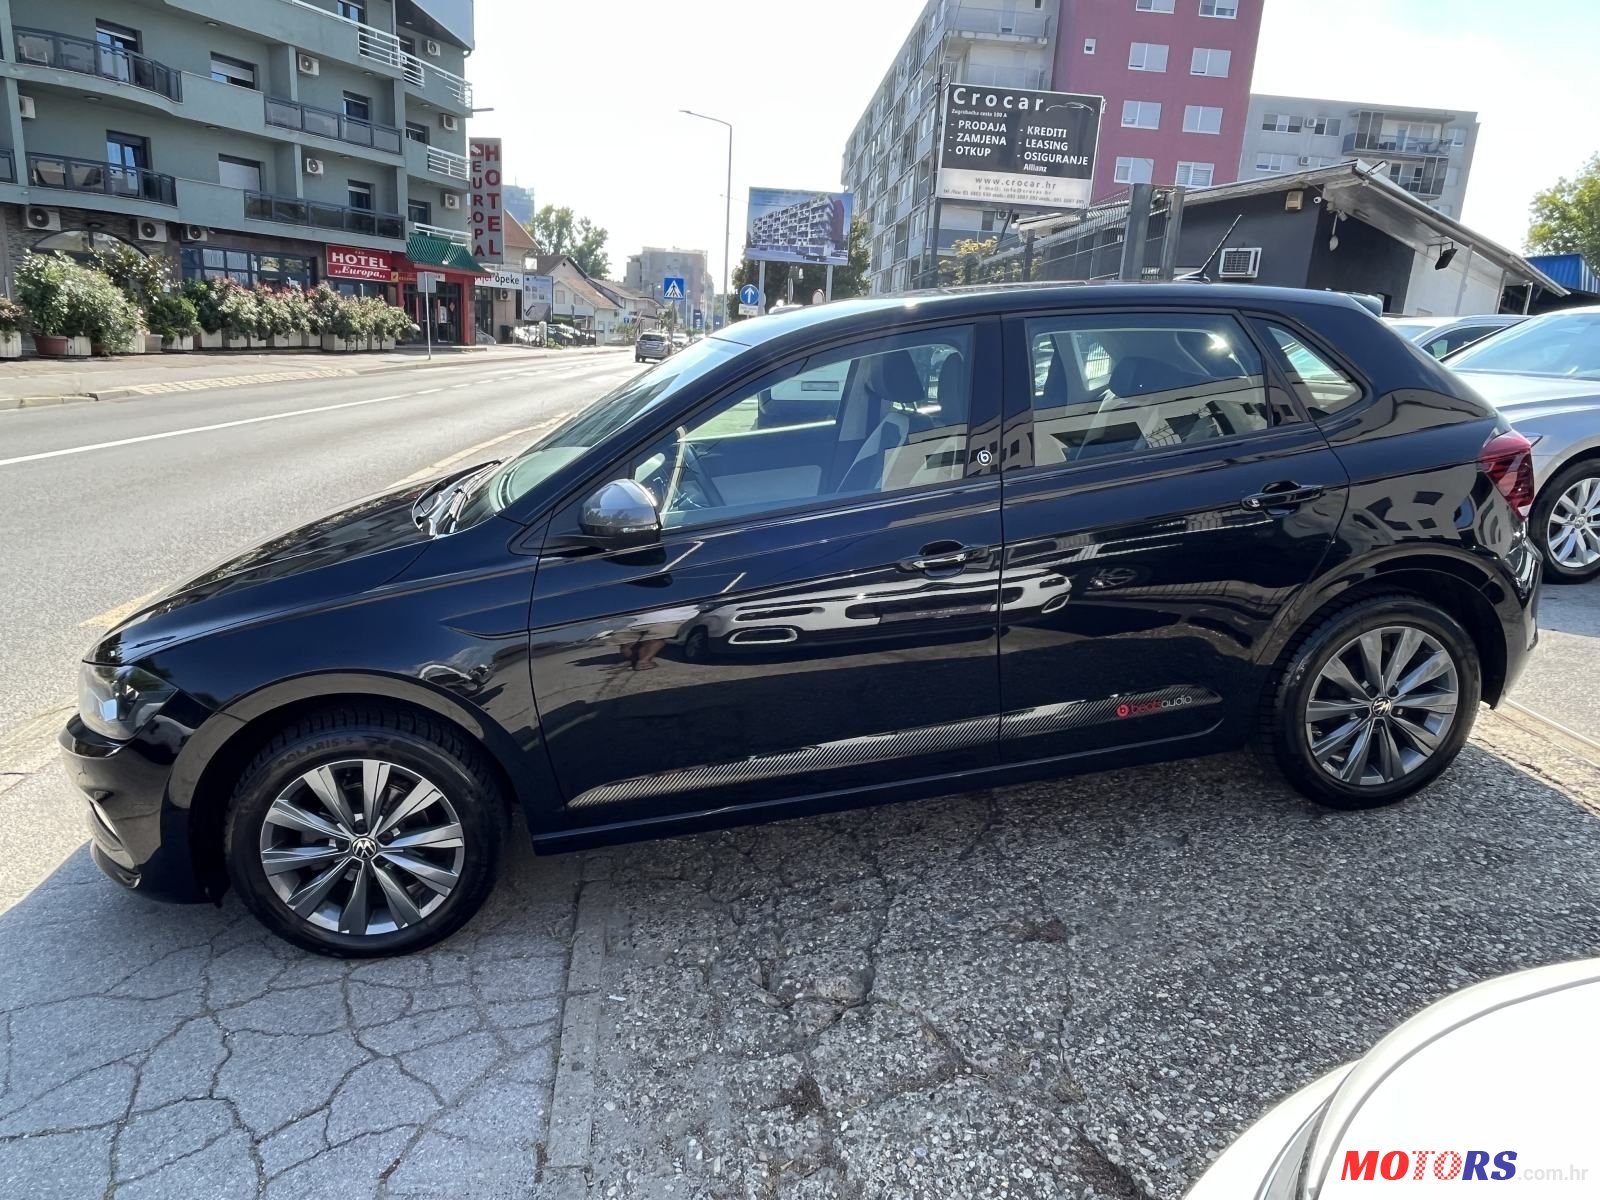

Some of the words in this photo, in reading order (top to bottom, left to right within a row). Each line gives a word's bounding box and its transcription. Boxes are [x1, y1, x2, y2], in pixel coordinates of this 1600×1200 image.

[953, 87, 1044, 111] Crocar
[958, 119, 1007, 133] PRODAJA
[1027, 125, 1067, 138] KREDITI
[956, 132, 1007, 145] ZAMJENA
[1025, 138, 1068, 151] LEASING
[955, 145, 991, 157] OTKUP
[1023, 151, 1089, 166] OSIGURANJE
[1023, 163, 1047, 173] Allianz
[975, 176, 1056, 191] www.crocar.hr
[485, 143, 501, 256] HOTEL
[472, 160, 485, 257] EUROPA
[331, 252, 388, 268] HOTEL
